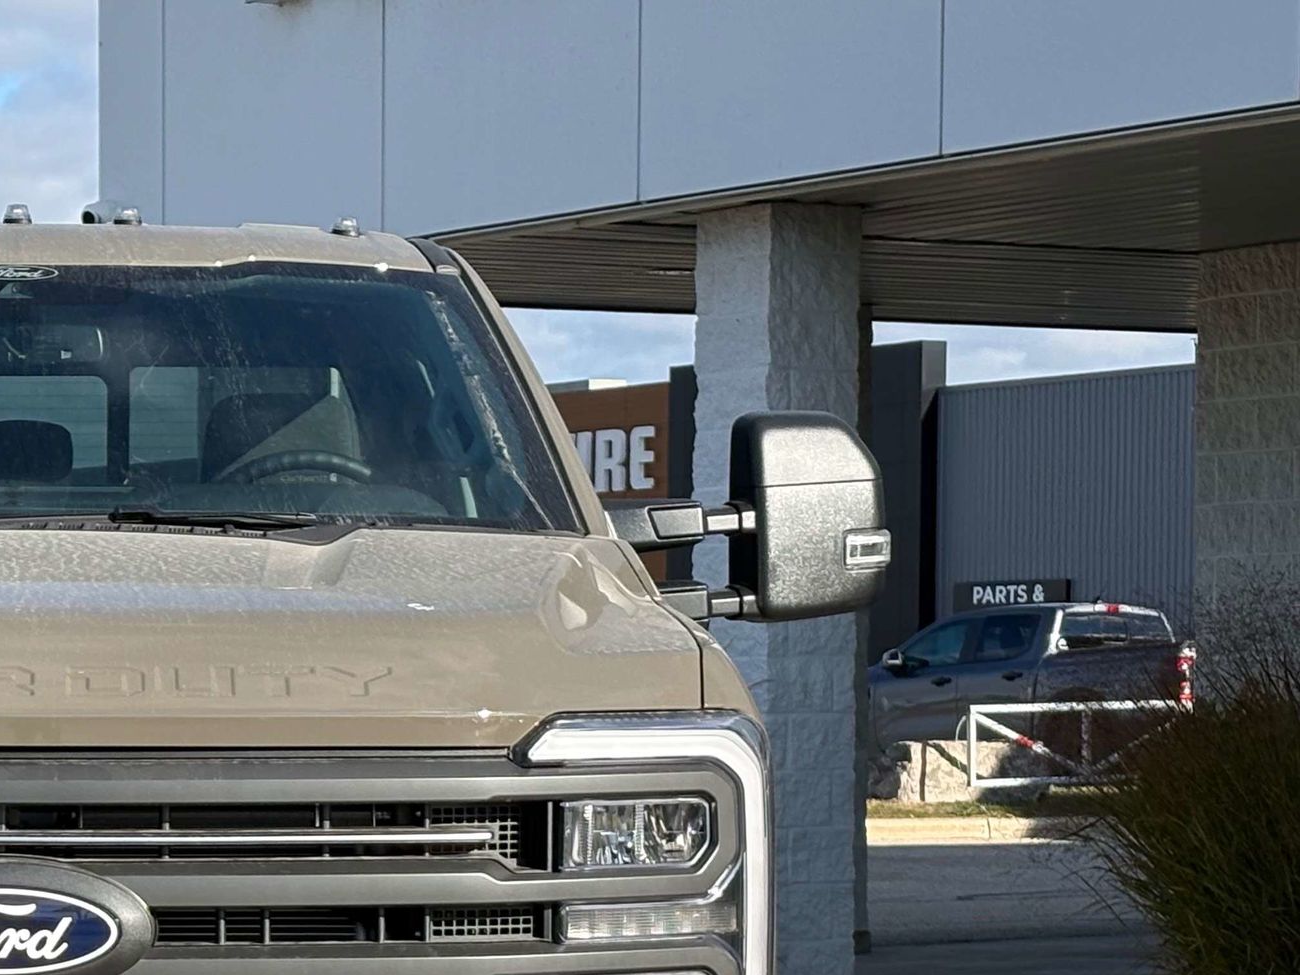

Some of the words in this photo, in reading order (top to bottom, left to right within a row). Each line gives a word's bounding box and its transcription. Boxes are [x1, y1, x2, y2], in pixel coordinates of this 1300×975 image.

[569, 425, 656, 493] IRE
[972, 585, 1028, 605] PARTS
[1032, 584, 1045, 602] &
[64, 664, 394, 698] DUTY
